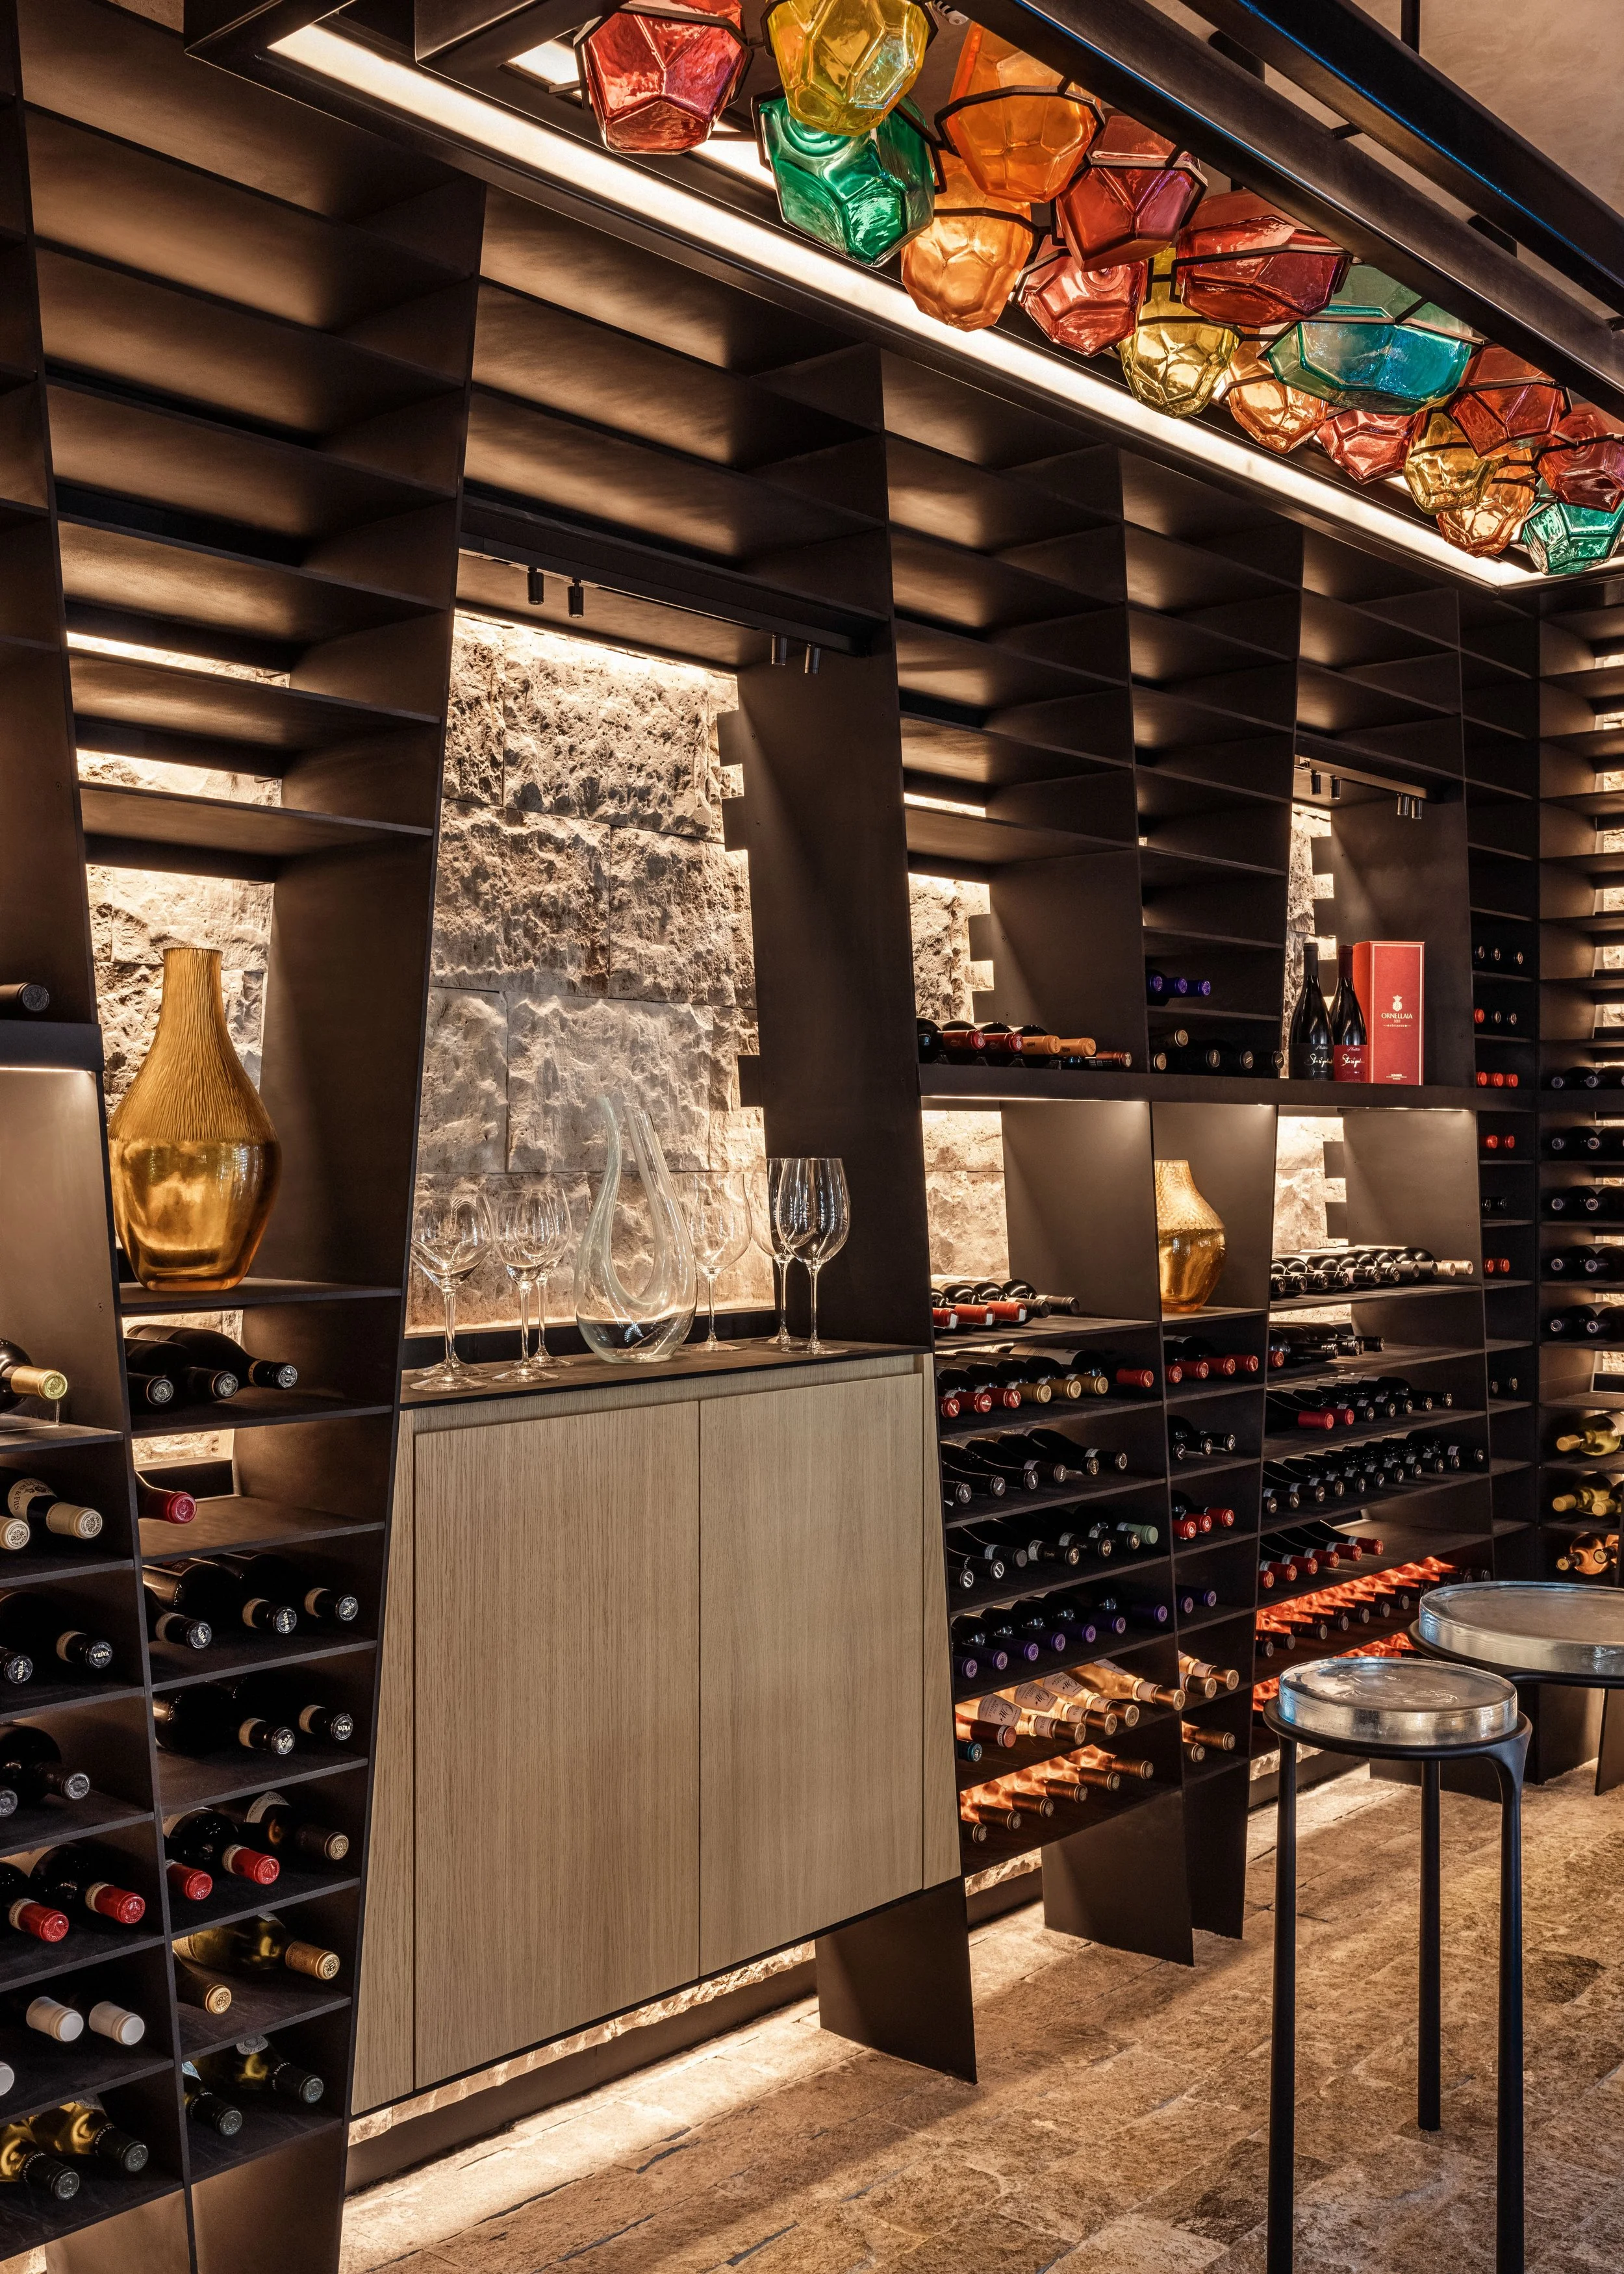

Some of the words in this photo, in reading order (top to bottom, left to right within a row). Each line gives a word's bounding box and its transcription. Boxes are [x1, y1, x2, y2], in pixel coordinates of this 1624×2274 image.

[342, 1602, 355, 1615] VAJRA
[197, 1626, 207, 1643] VAJRA
[93, 1650, 110, 1659] VAJRA
[279, 1734, 291, 1749] VAJRA
[24, 2152, 46, 2168] WILLIAM
